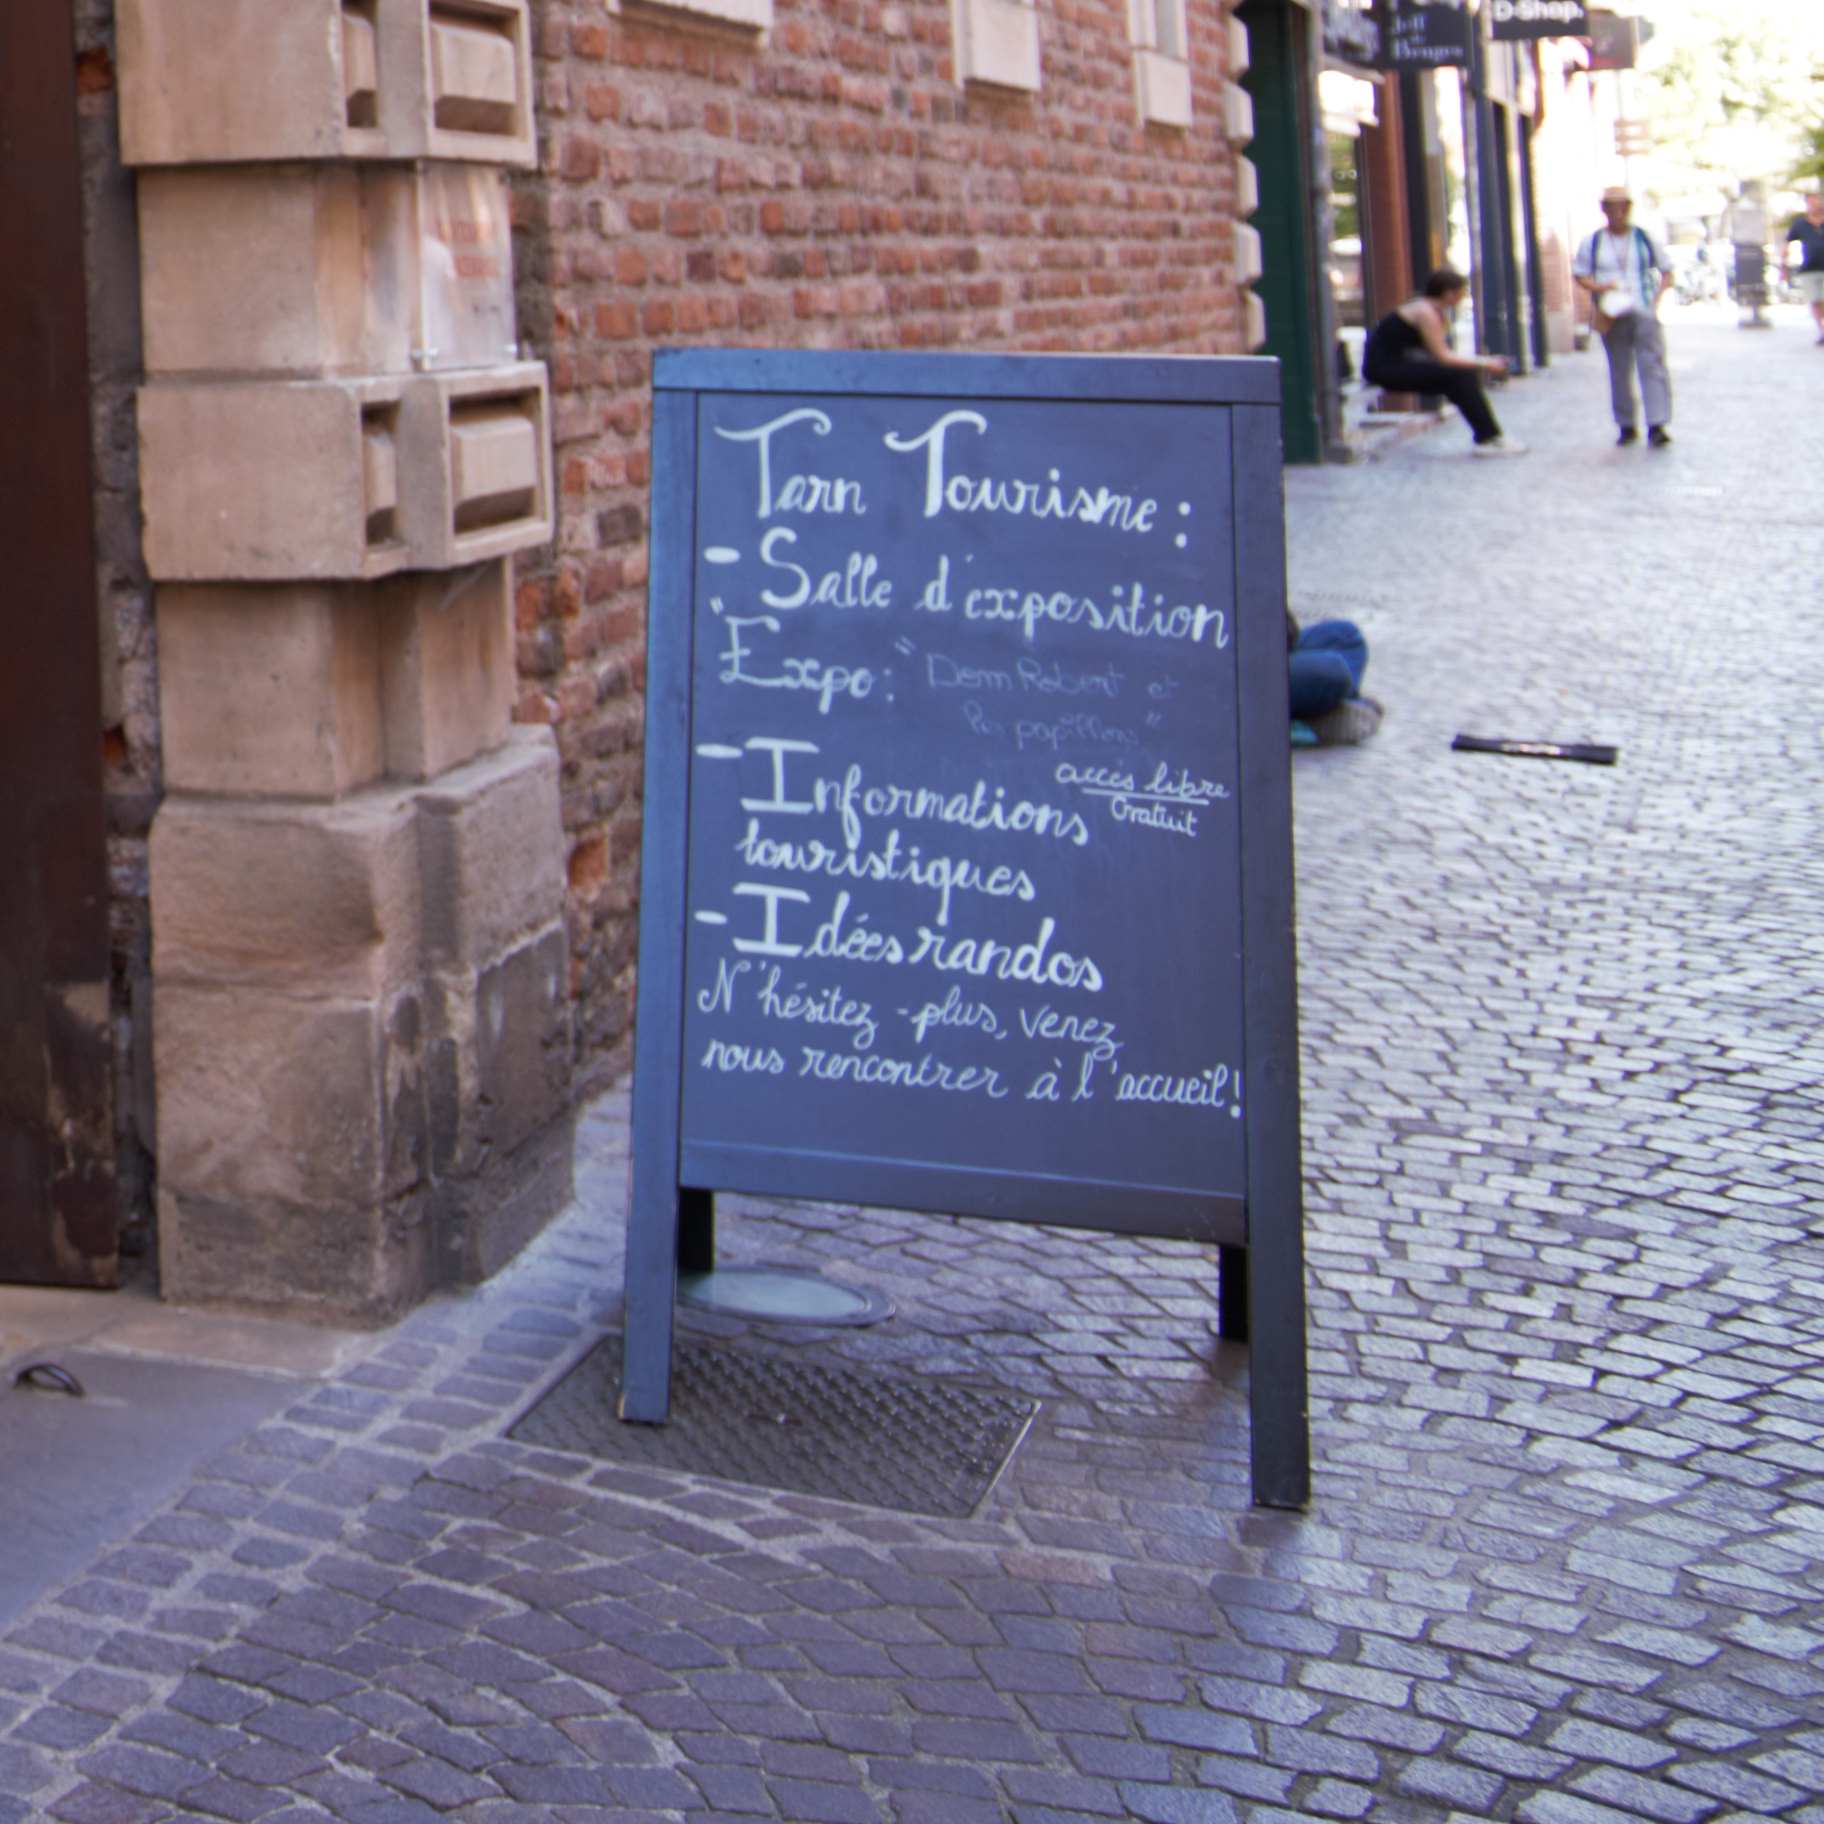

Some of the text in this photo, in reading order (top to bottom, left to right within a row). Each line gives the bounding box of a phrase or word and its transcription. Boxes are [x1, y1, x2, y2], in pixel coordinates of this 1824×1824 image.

[714, 408, 866, 519] Tarn
[883, 410, 1158, 533] Tourisme
[759, 527, 892, 609] Salle
[913, 553, 1230, 649] d'exposition
[741, 736, 1090, 849] Informations
[1055, 758, 1231, 801] accès libre
[1110, 796, 1199, 837] Gratuit
[734, 817, 1036, 926] touristiques
[731, 881, 904, 965] Idées
[908, 917, 1103, 992] randos
[697, 957, 879, 1049] N'hésitez
[702, 1039, 785, 1074] nous
[800, 1044, 1009, 1099] rencontrer
[1026, 1056, 1061, 1101] à
